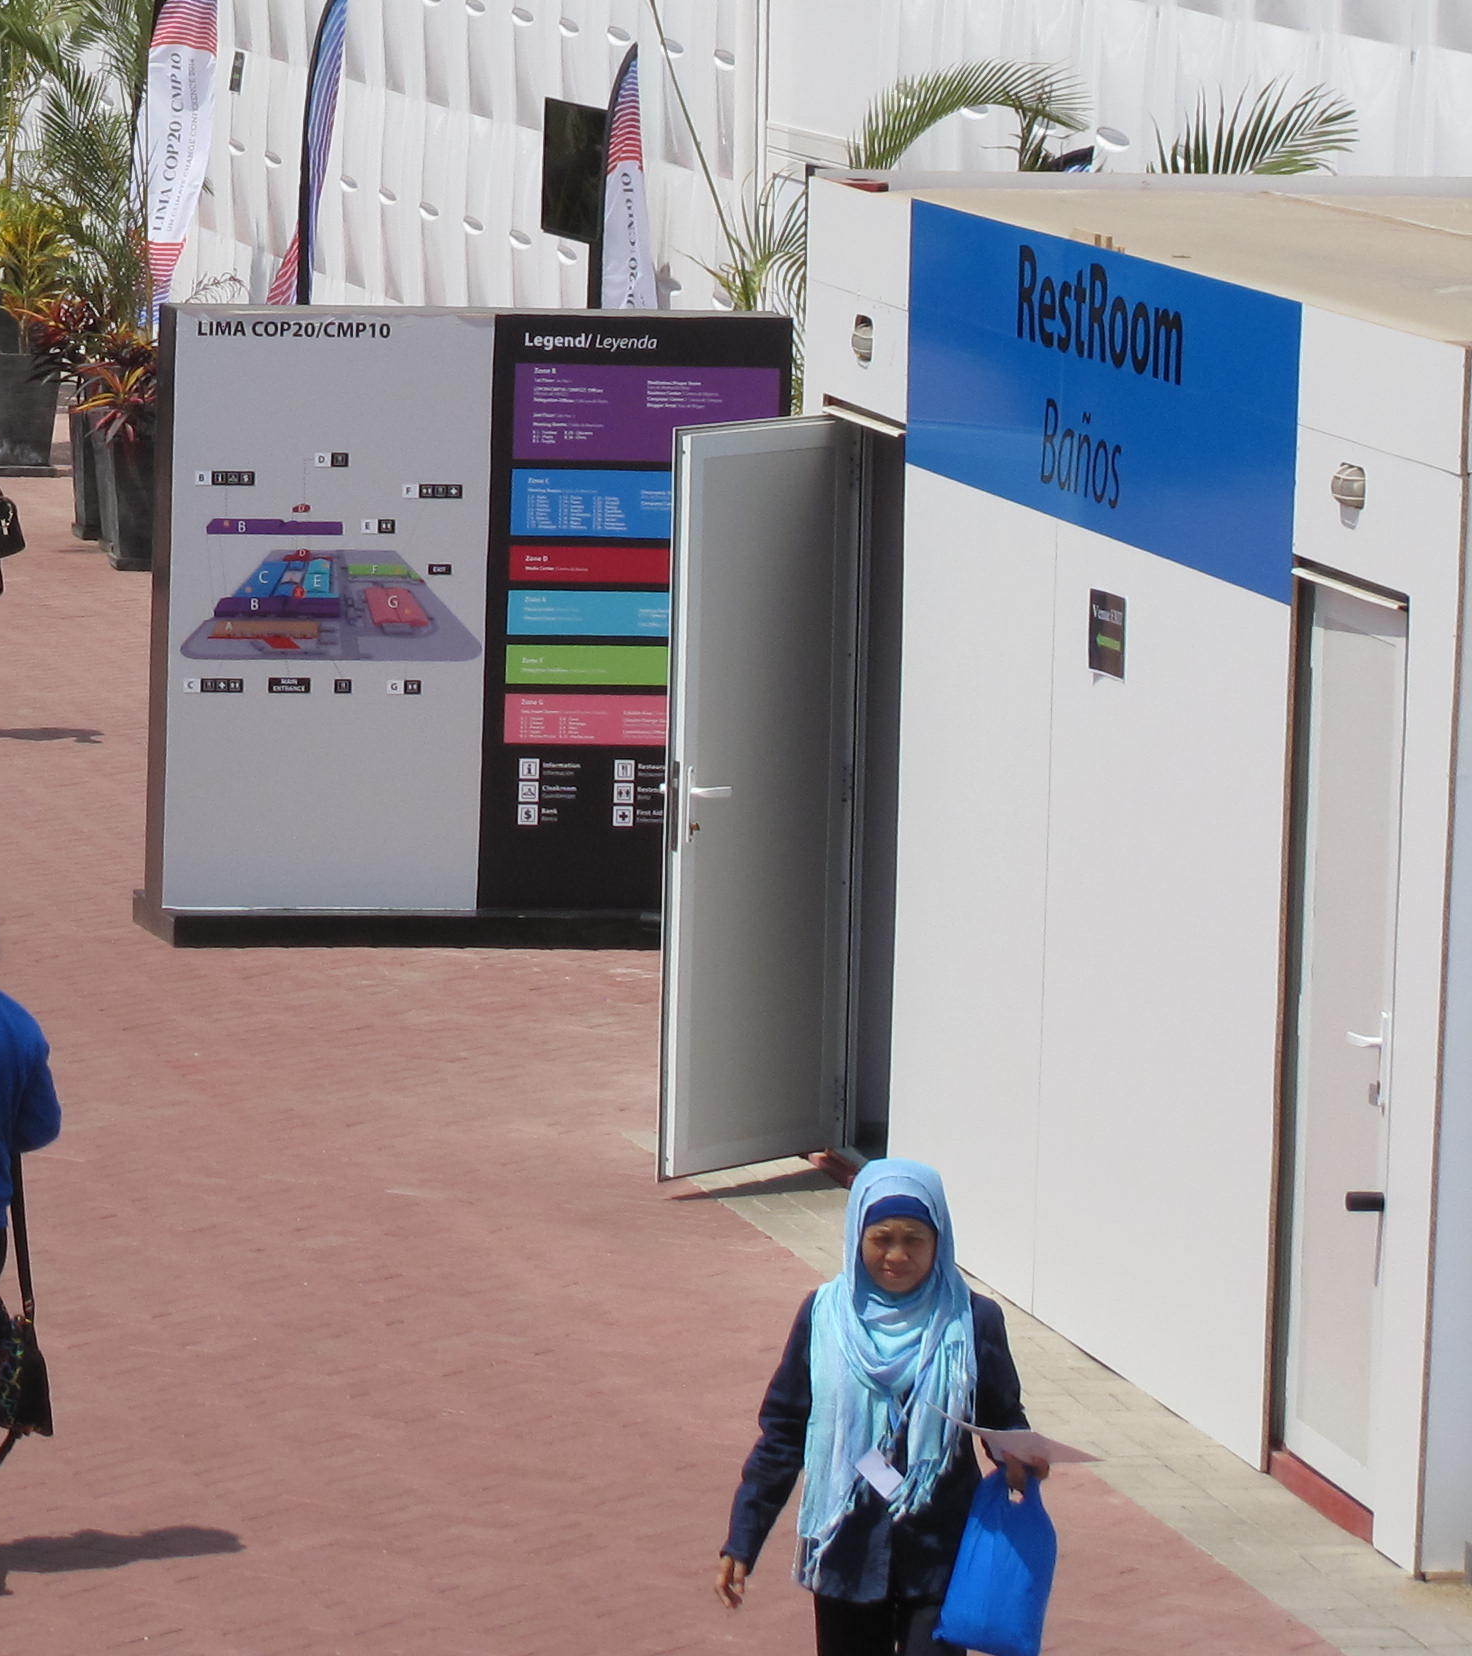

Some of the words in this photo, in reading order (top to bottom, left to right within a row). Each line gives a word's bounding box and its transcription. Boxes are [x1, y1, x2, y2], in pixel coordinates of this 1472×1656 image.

[152, 187, 173, 231] LIMA
[163, 121, 183, 182] COP20
[1017, 244, 1183, 385] RestRoom
[197, 320, 246, 337] LIMA
[251, 320, 391, 339] COP20/CMP10
[525, 332, 593, 351] Legend/
[596, 334, 658, 352] Leyenda
[1040, 397, 1122, 509] Baños
[238, 521, 246, 533] B
[259, 571, 269, 584] C
[314, 575, 321, 587] E
[251, 599, 259, 610] B
[387, 595, 398, 608] G
